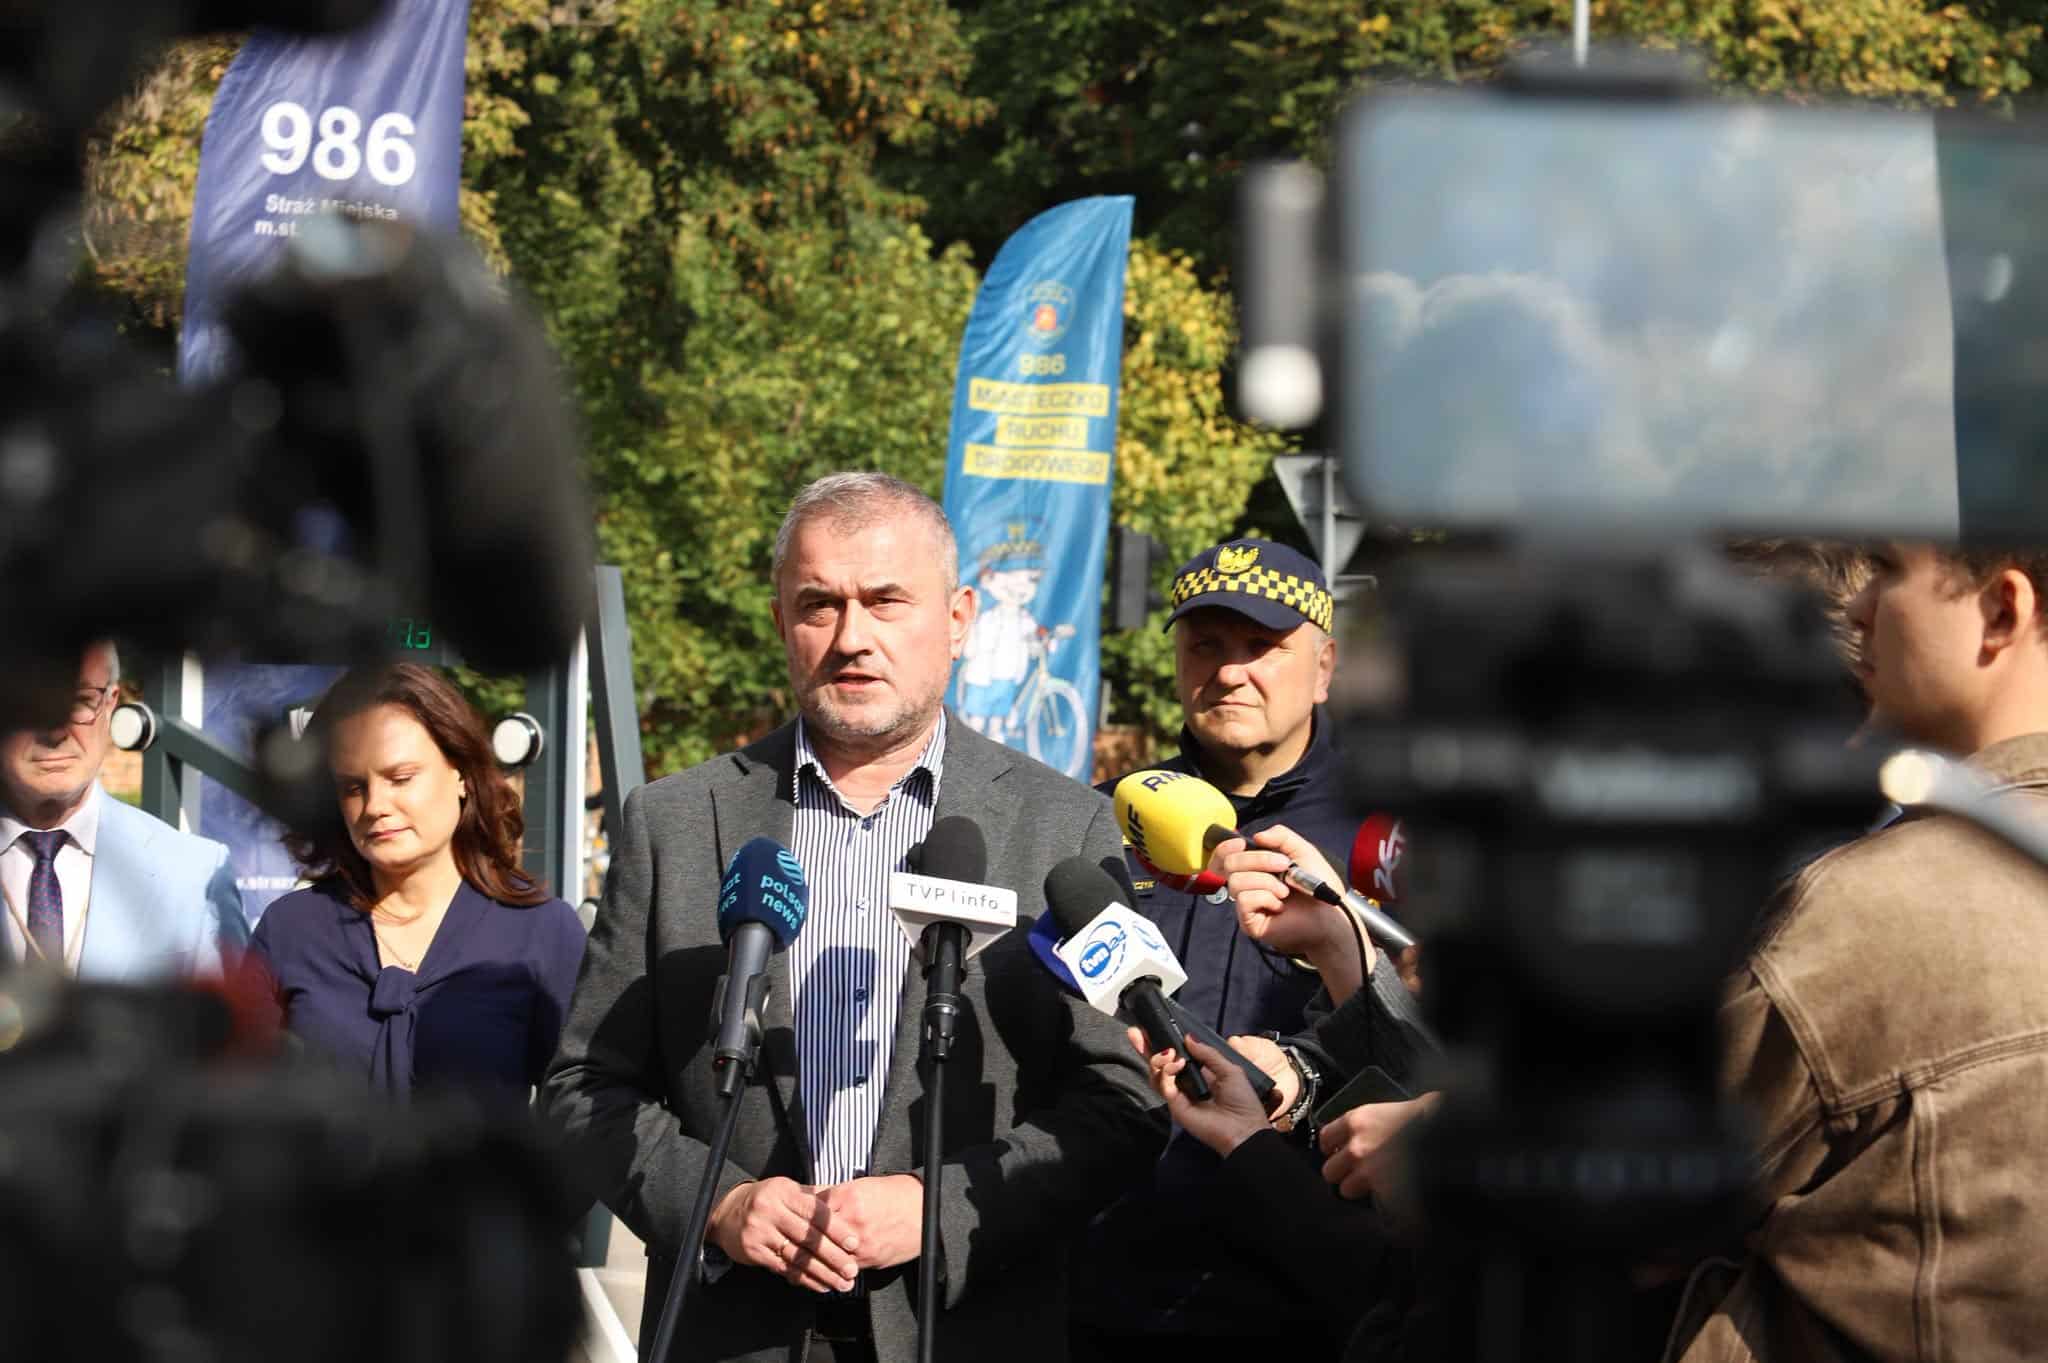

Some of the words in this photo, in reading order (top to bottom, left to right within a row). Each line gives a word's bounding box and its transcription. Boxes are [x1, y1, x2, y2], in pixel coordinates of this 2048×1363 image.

[261, 102, 416, 185] 986
[1018, 352, 1066, 376] 986
[760, 874, 805, 919] polsat
[906, 882, 945, 901] TVP
[762, 893, 798, 929] news
